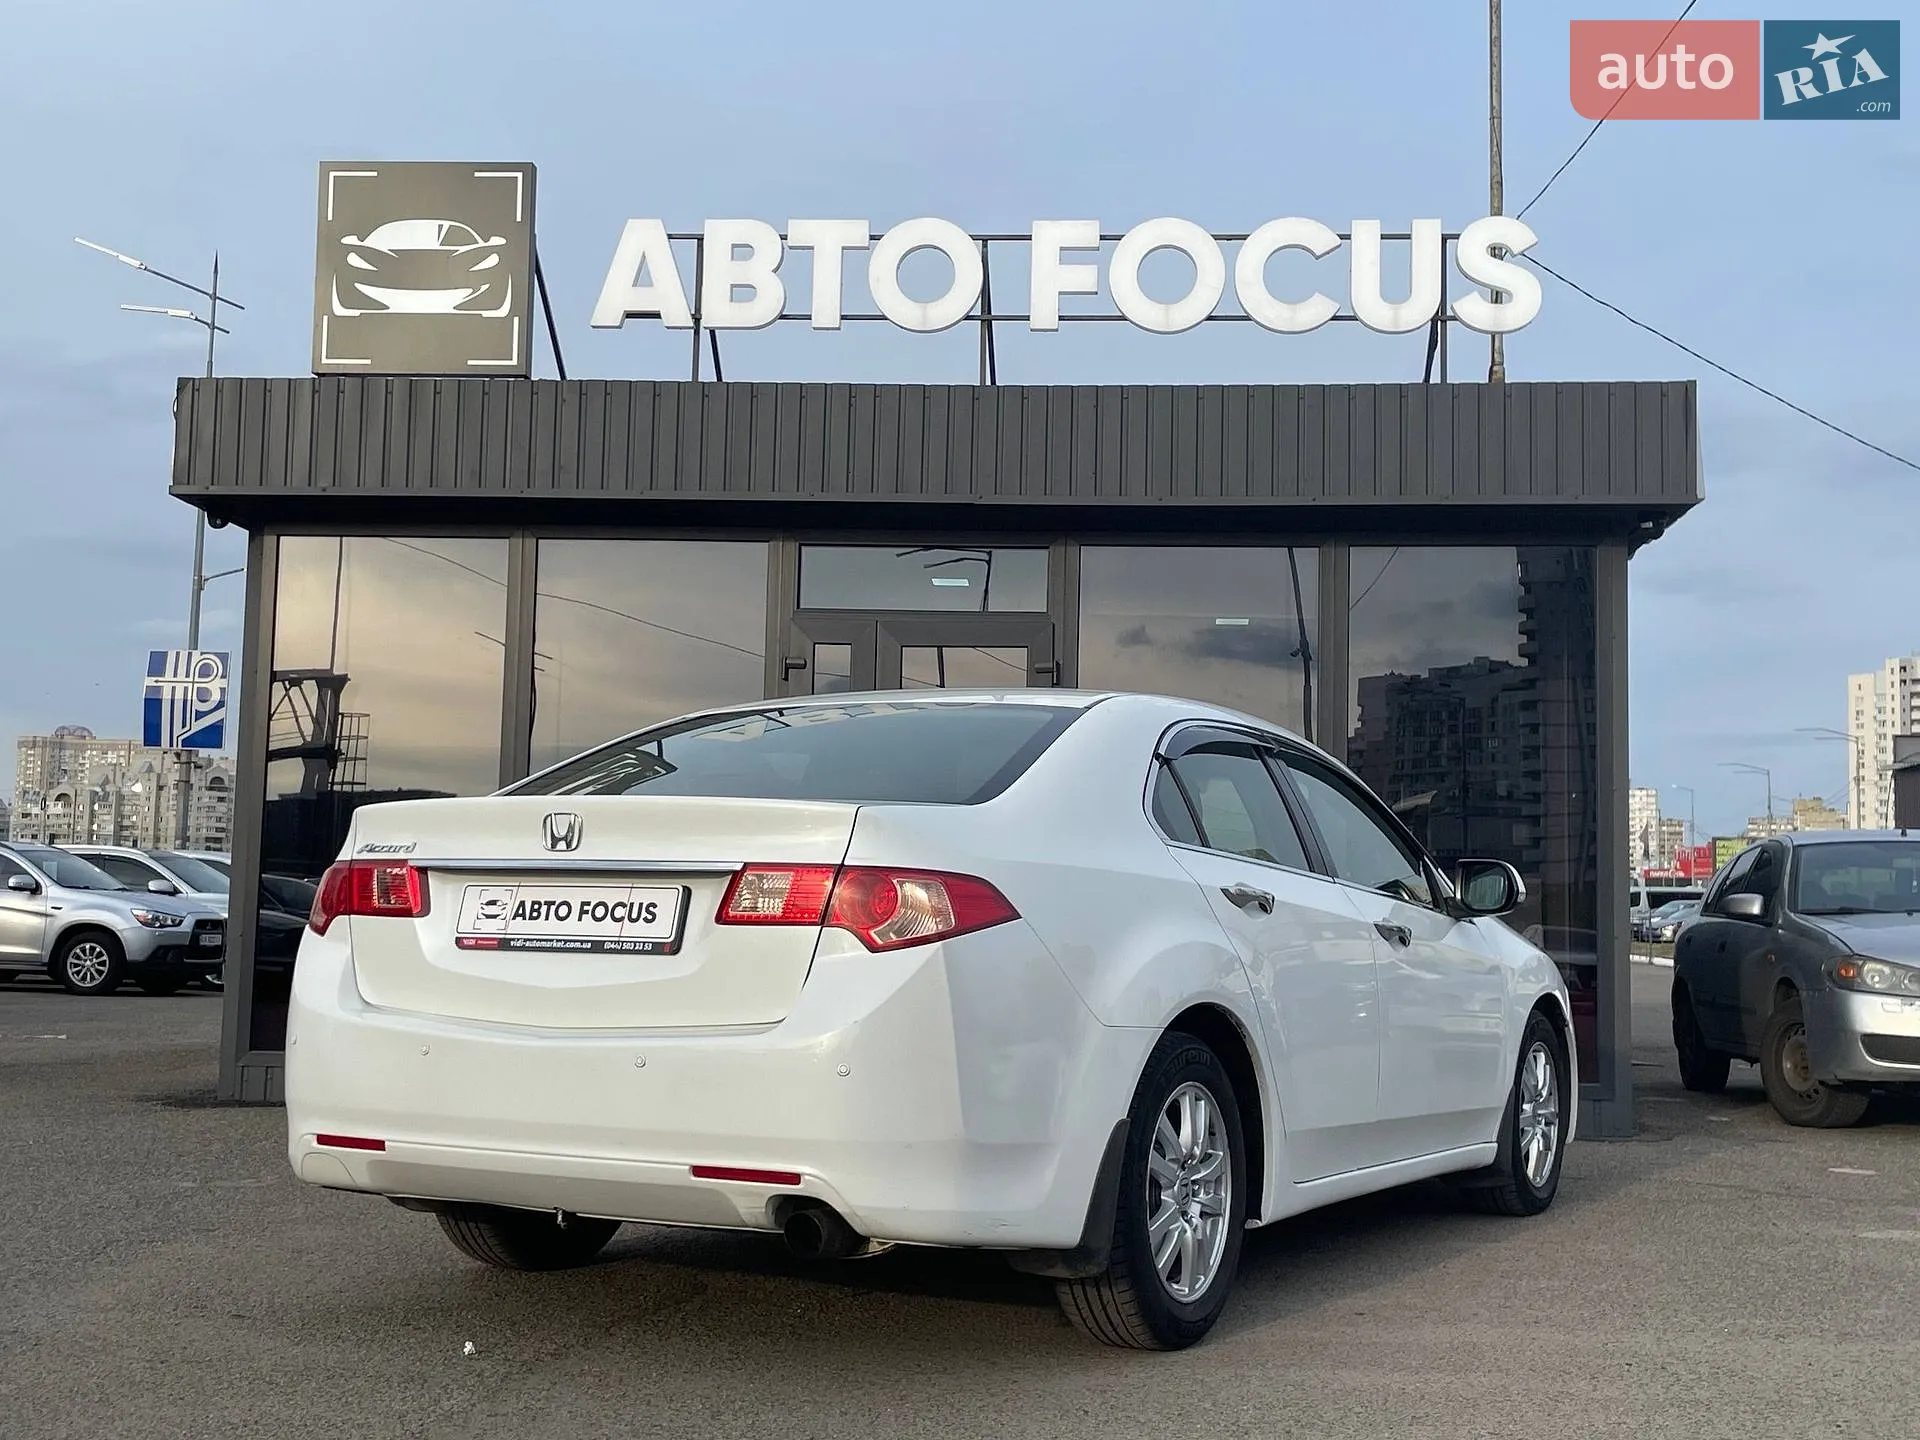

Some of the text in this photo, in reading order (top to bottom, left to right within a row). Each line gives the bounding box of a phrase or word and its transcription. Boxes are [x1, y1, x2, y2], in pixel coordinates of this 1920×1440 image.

[590, 216, 1542, 334] АВТО FOCUS
[357, 842, 416, 854] Accord
[512, 900, 658, 923] АВТО FOCUS
[510, 940, 591, 949] vidi-automarket.com.ua
